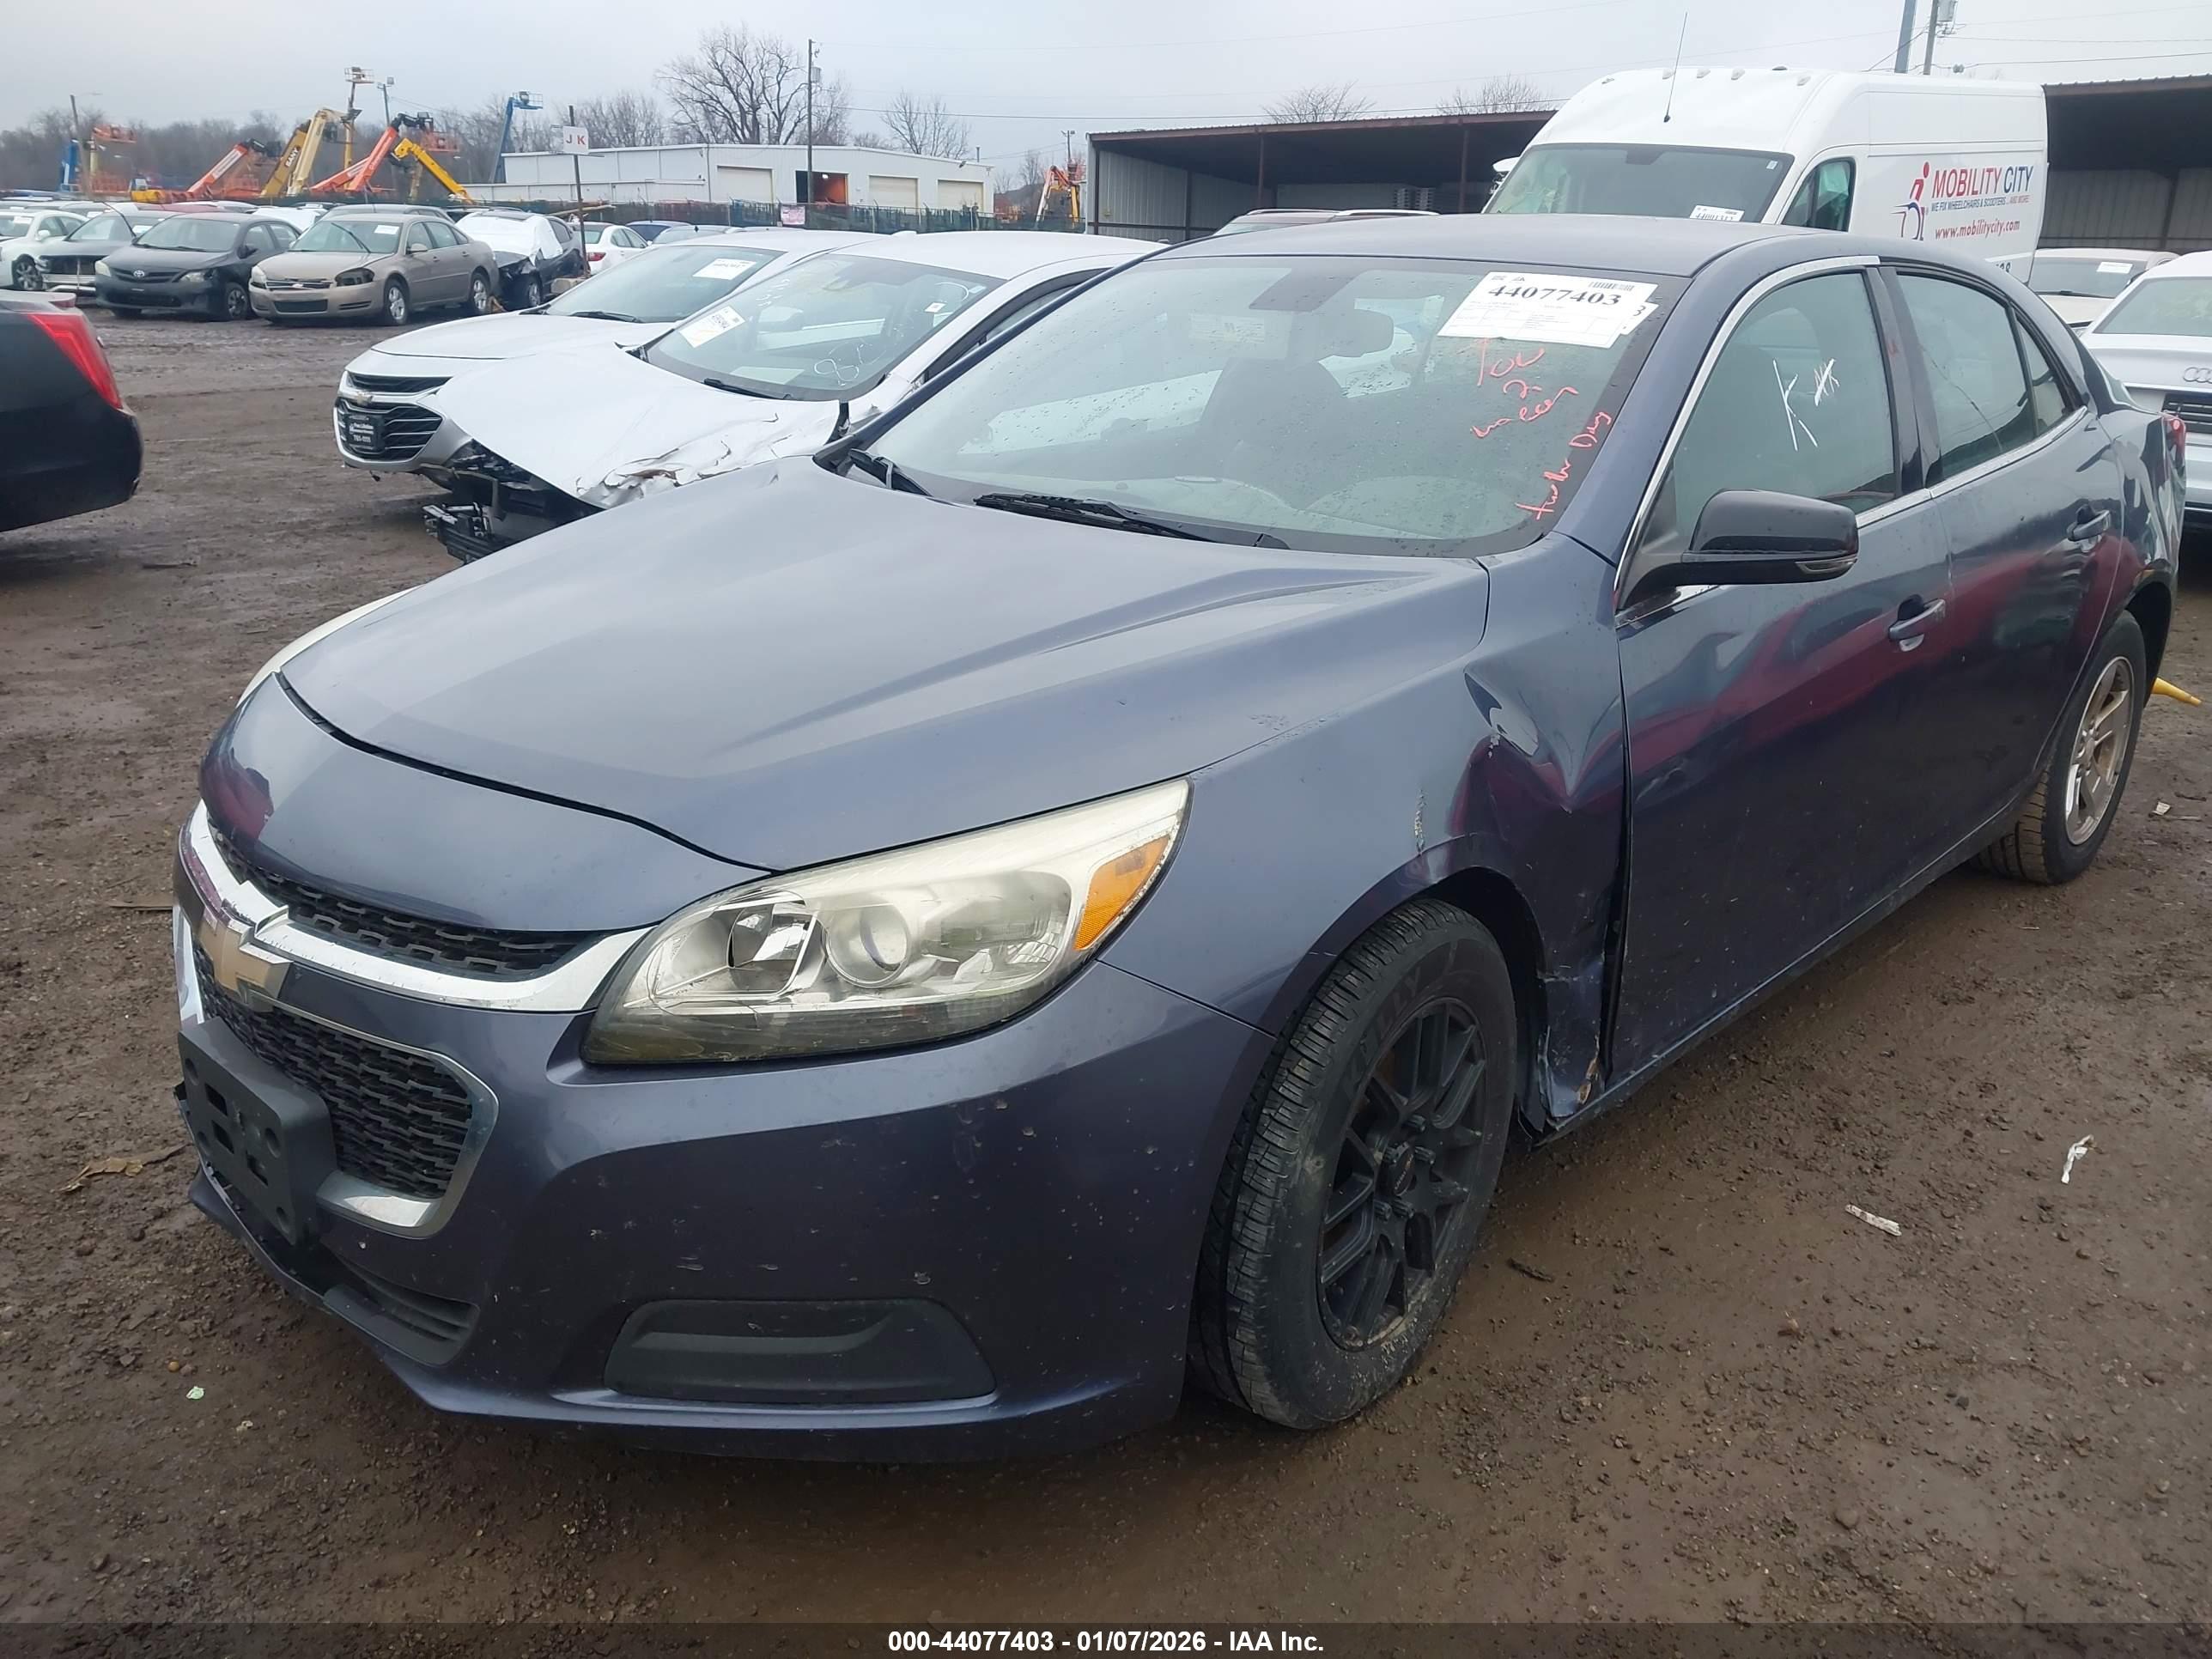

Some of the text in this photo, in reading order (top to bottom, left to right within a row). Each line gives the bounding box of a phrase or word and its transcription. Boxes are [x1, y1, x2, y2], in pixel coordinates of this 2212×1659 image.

[565, 133, 586, 145] J K
[1932, 166, 2034, 199] MOBILITY CITY
[1935, 218, 2021, 240] www.mobilitycity.com
[1487, 284, 1622, 306] 44077403
